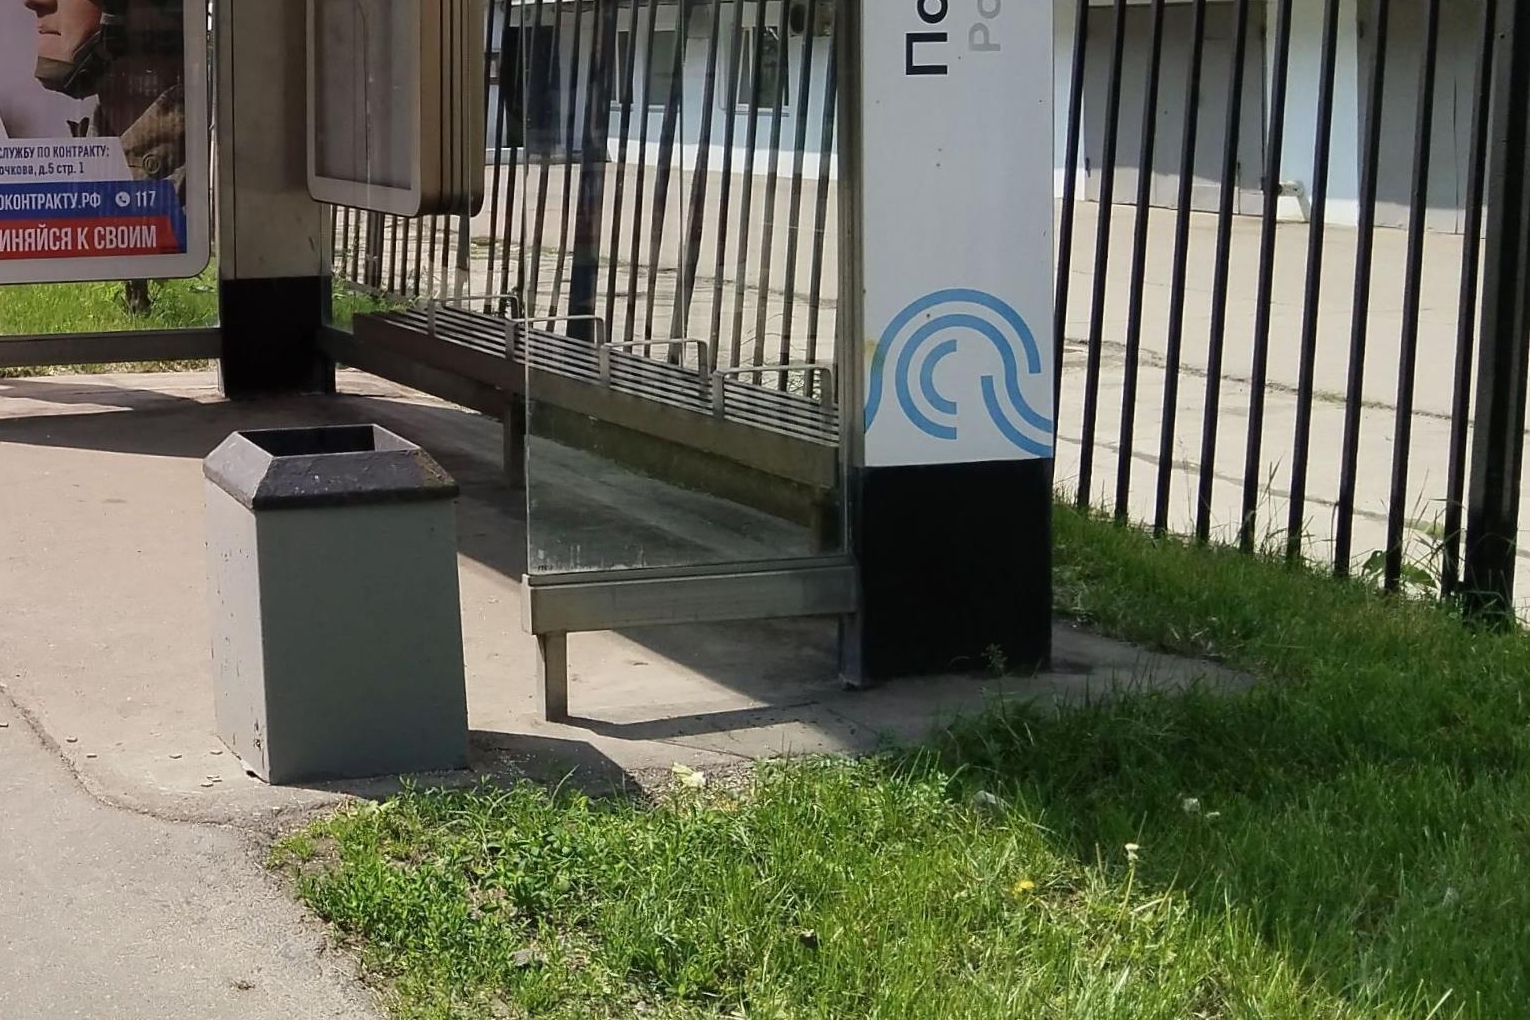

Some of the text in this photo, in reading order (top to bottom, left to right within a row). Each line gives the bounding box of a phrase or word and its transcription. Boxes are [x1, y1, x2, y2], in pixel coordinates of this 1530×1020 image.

[37, 146, 51, 158] ПО
[53, 145, 110, 158] КОНТРАКТУ:
[56, 163, 77, 176] стр.
[79, 161, 84, 174] 1
[135, 190, 156, 208] 117
[77, 227, 89, 250] К
[94, 225, 157, 250] СВОИМ
